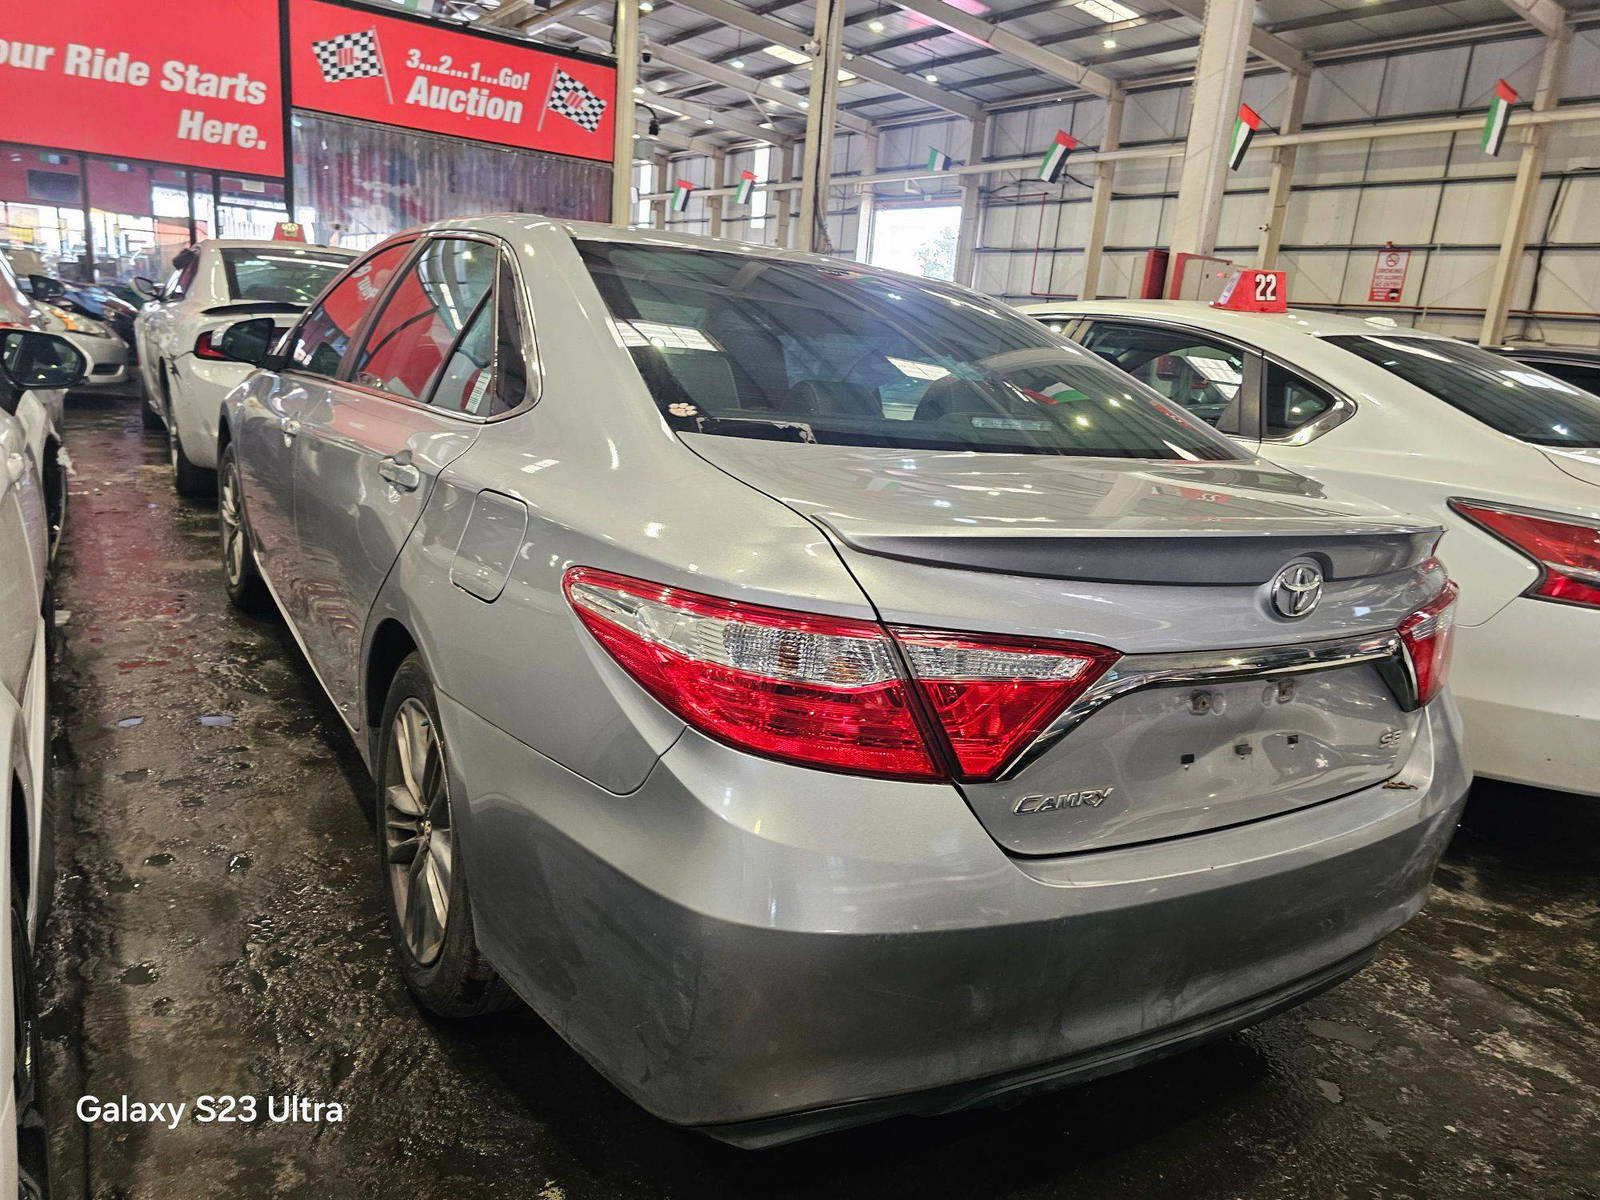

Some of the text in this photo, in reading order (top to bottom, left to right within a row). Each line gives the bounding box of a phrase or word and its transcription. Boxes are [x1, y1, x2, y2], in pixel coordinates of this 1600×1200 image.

[63, 43, 150, 87] Ride
[160, 60, 267, 105] Starts
[405, 48, 531, 91] 3...2...1...Go!
[405, 75, 524, 124] Auction
[176, 108, 267, 150] Here.
[1254, 273, 1277, 301] 22
[1013, 787, 1115, 815] CAMRY
